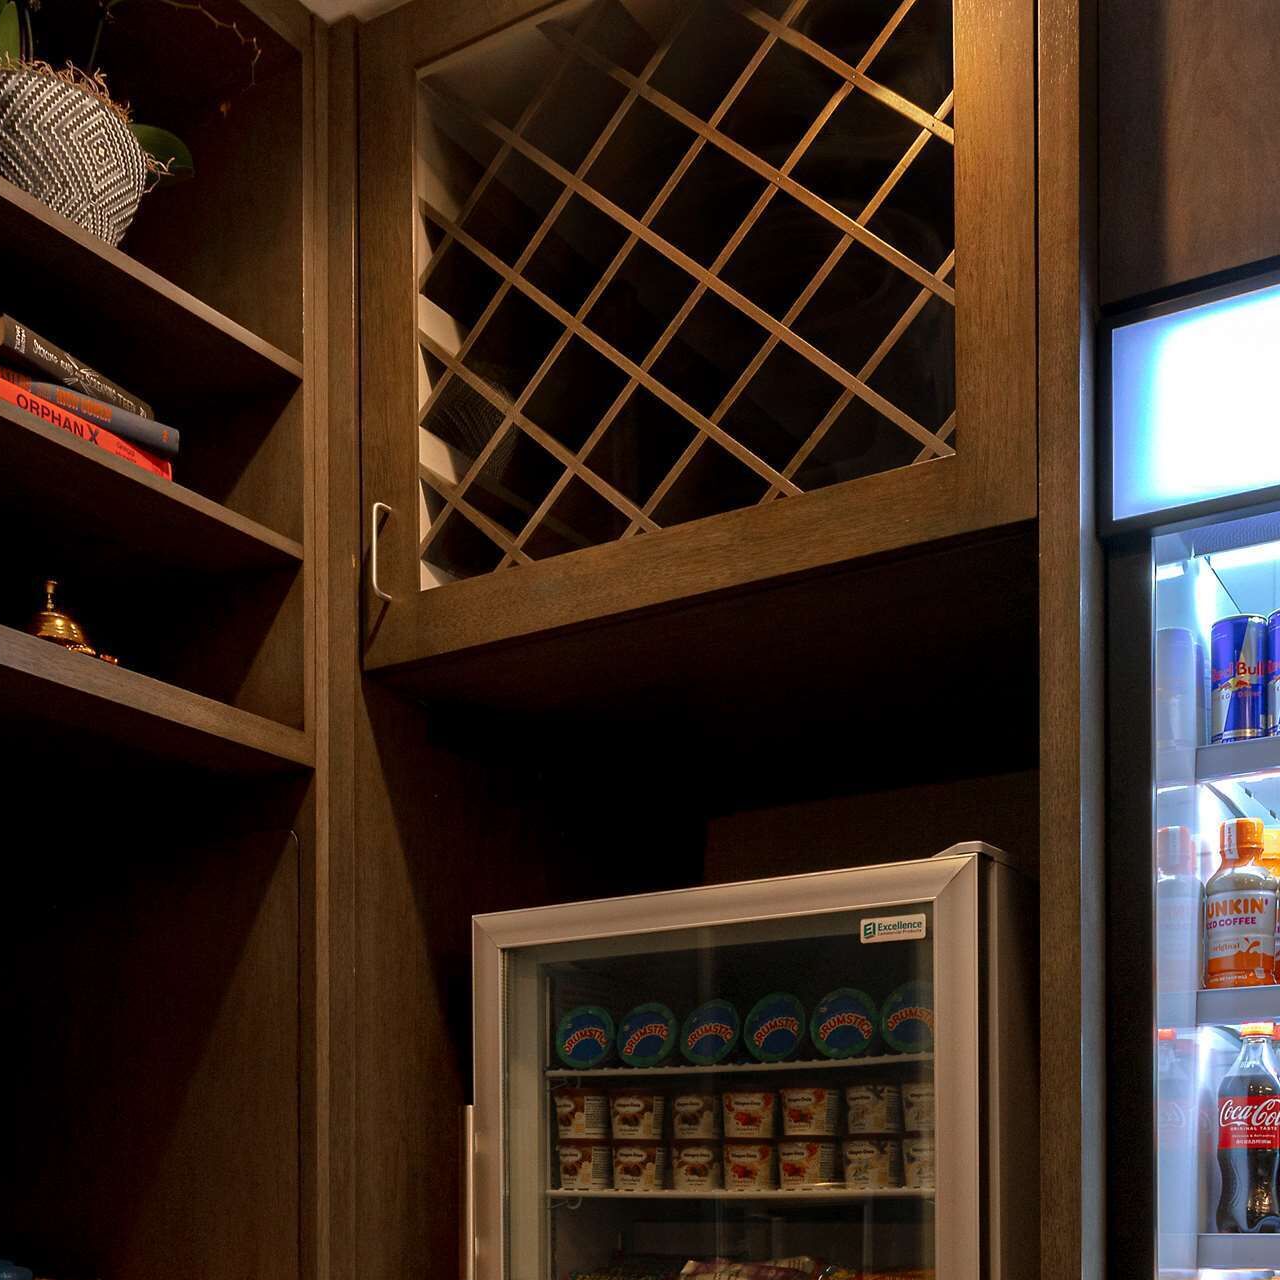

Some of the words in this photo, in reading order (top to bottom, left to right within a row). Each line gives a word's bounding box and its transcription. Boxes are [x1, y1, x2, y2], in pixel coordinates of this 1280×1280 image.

[17, 394, 84, 438] ORPHAN
[84, 424, 99, 445] X
[1206, 898, 1269, 916] UNKIN'
[878, 921, 922, 931] Excellence
[1220, 916, 1256, 926] COFFEE
[820, 1012, 872, 1041] DRUMSTICK
